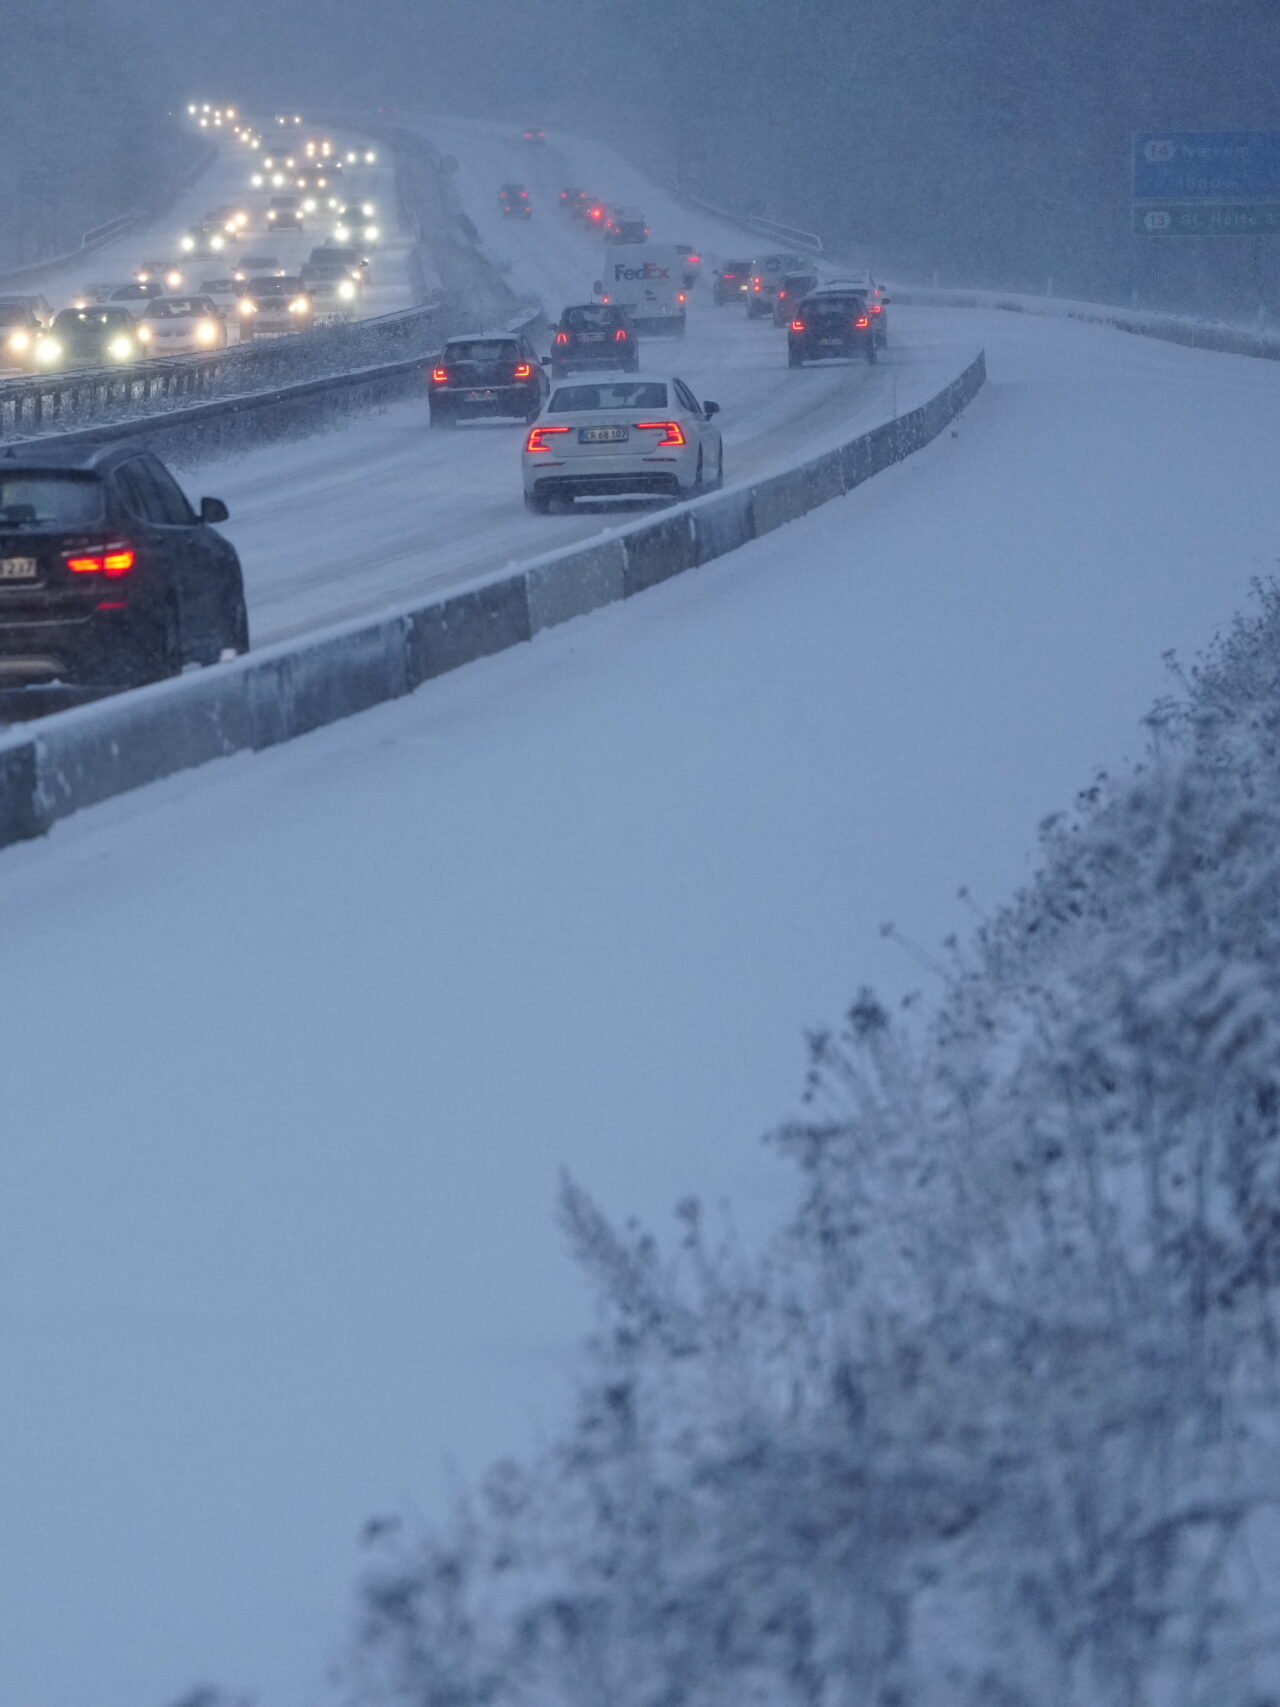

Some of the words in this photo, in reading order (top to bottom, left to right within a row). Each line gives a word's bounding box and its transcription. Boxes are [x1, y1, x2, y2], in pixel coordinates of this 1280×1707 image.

[1151, 144, 1170, 157] 14
[1151, 214, 1166, 226] 13
[614, 262, 669, 282] FedEx
[611, 429, 626, 439] 107
